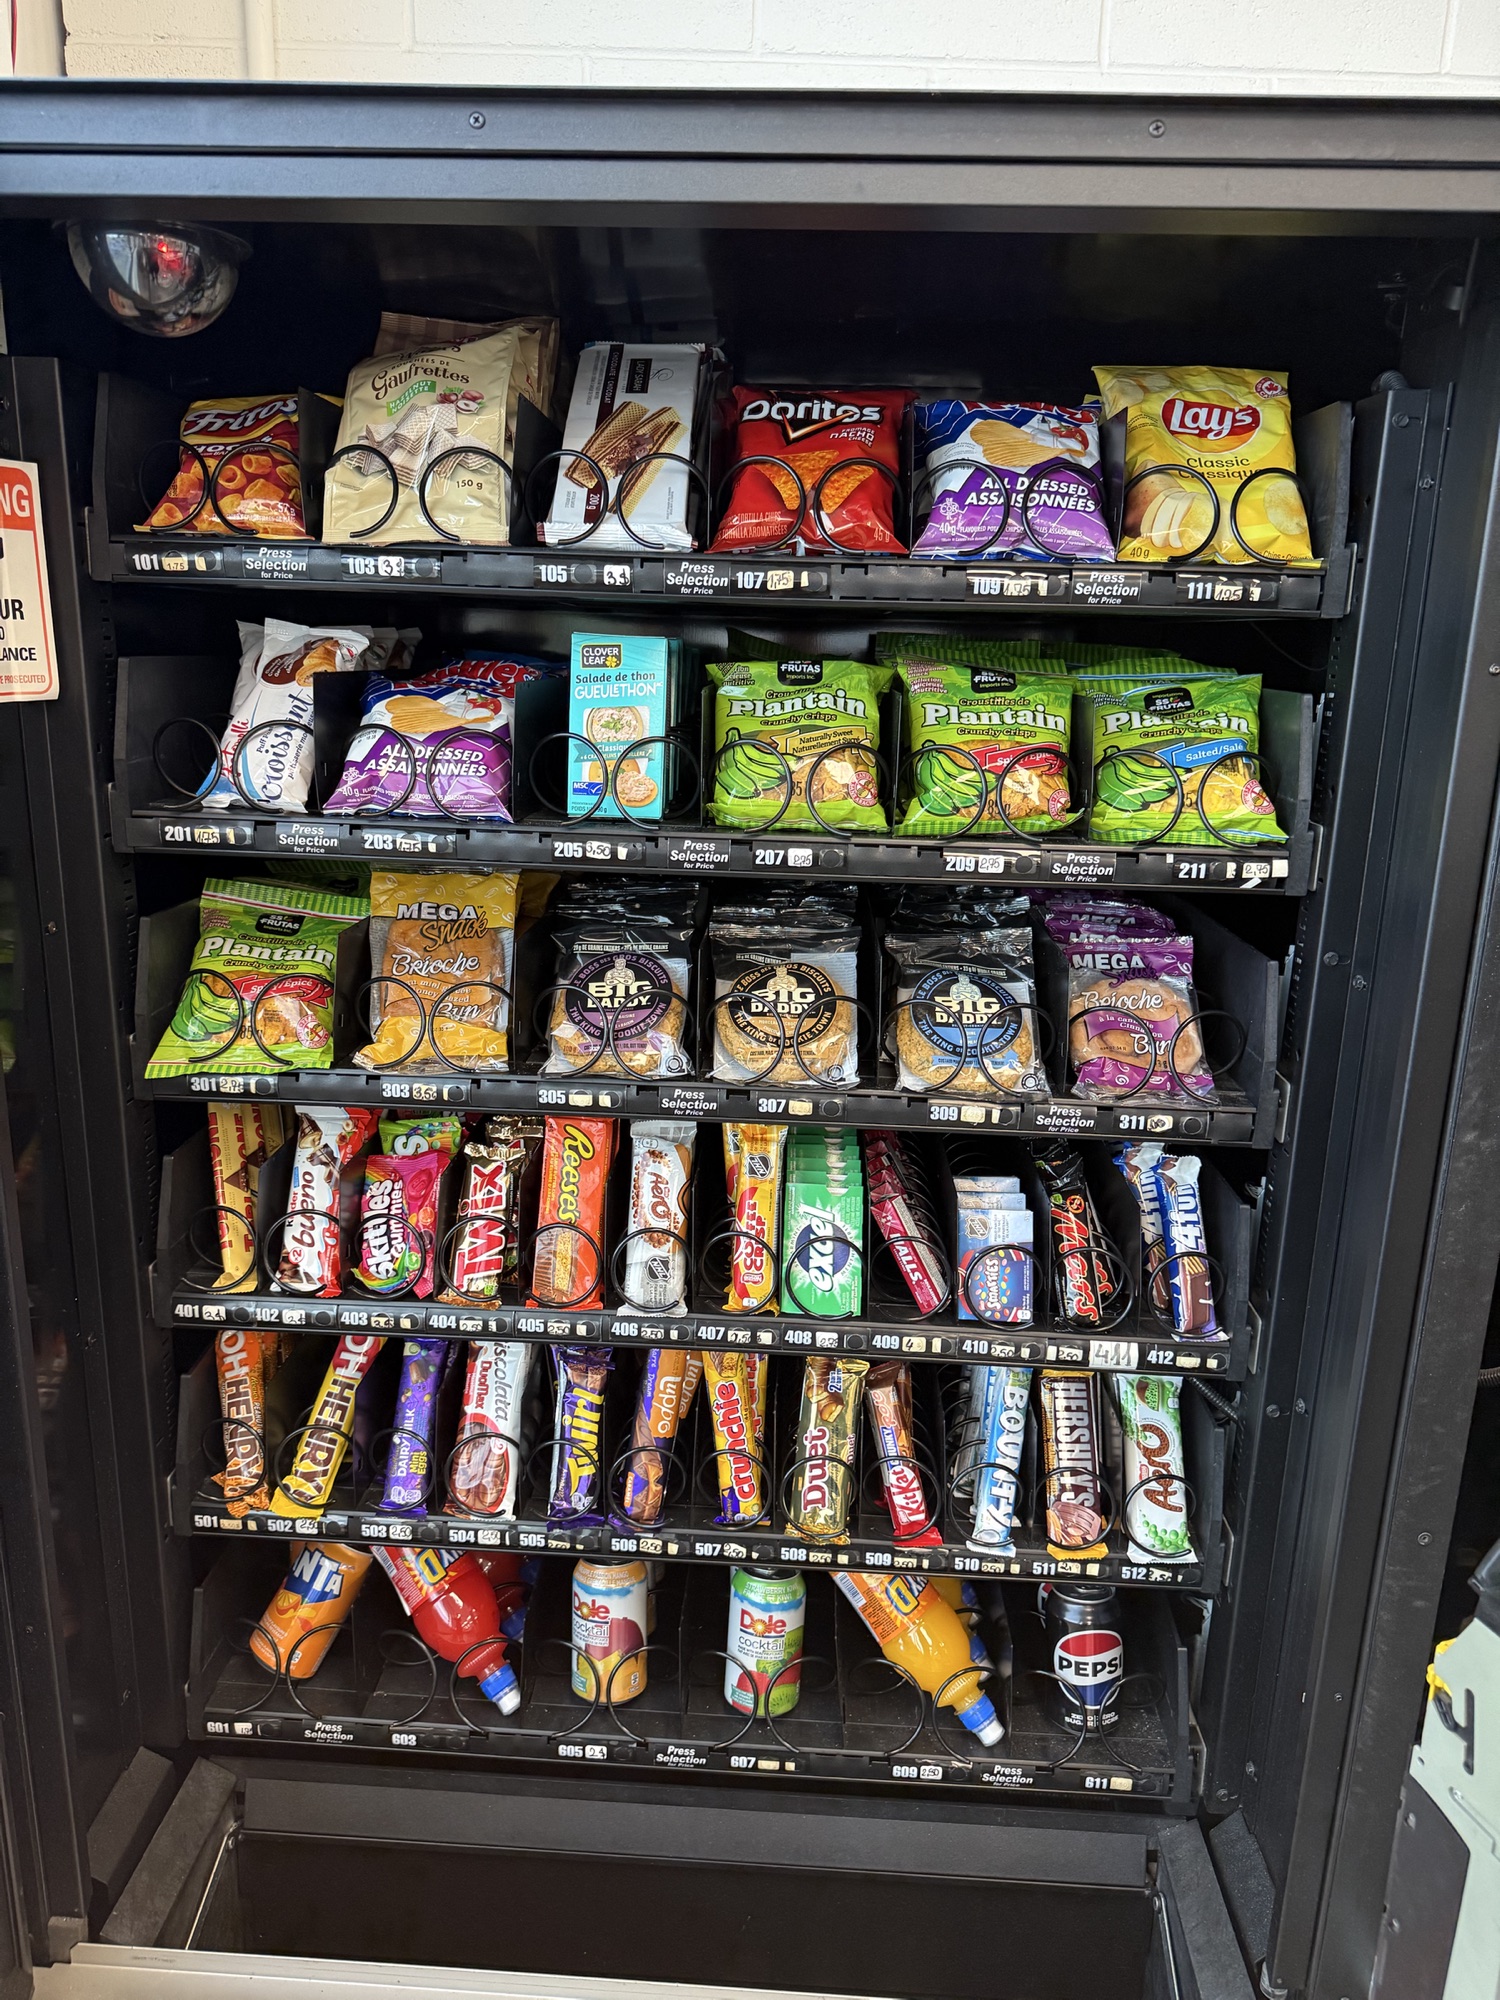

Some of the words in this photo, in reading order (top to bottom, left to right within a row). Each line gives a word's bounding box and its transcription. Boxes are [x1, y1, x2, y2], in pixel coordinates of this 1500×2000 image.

[371, 364, 470, 401] Gaufrettes
[183, 397, 299, 437] Fritos
[741, 400, 884, 423] Doritos
[1169, 399, 1253, 440] Lay's
[841, 427, 875, 435] FROMAGE
[1186, 456, 1250, 469] Classic
[456, 479, 474, 489] 150
[476, 481, 484, 491] g
[749, 523, 788, 538] AROMATISÉES
[873, 527, 883, 541] 45
[939, 522, 950, 534] 40
[259, 547, 292, 559] Press
[1130, 548, 1142, 558] 40
[132, 553, 160, 570] 101
[167, 562, 185, 570] 1.75
[245, 557, 306, 571] Selection
[349, 557, 376, 575] 103
[680, 562, 714, 573] Press
[539, 564, 568, 583] 105
[666, 572, 729, 586] Selection
[736, 572, 764, 589] 107
[1090, 571, 1125, 583] Press
[973, 578, 1000, 595] 109
[1074, 582, 1139, 597] Selection
[1187, 582, 1213, 599] 111
[583, 647, 619, 658] CLOVER
[583, 656, 606, 666] LEAF
[780, 662, 820, 674] FRUTAS
[575, 673, 612, 684] Salade
[615, 672, 627, 682] de
[630, 671, 656, 681] thon
[723, 678, 755, 686] nutritive
[574, 682, 656, 700] GUEULETHON
[1152, 691, 1184, 699] Importations
[726, 687, 869, 720] Plantain
[959, 697, 1016, 707] Croustilles
[1017, 697, 1030, 706] de
[760, 715, 802, 727] Crunchy
[804, 711, 838, 722] Crisps
[921, 703, 1067, 735] Plantain
[799, 732, 833, 745] Naturally
[833, 728, 854, 739] Sweet
[957, 727, 1001, 738] Crunchy
[1002, 727, 1037, 738] Crisps
[1140, 727, 1186, 739] Crunchy
[1186, 742, 1244, 762] Salted/Salé
[573, 781, 589, 789] MSC
[164, 826, 193, 842] 201
[291, 823, 325, 834] Press
[278, 834, 338, 847] Selection
[364, 834, 393, 849] 203
[683, 841, 715, 850] Press
[554, 841, 583, 858] 205
[670, 850, 728, 862] Selection
[755, 850, 784, 865] 207
[946, 856, 976, 872] 209
[1067, 853, 1100, 864] Press
[1052, 863, 1113, 877] Selection
[1178, 863, 1206, 878] 211
[396, 902, 479, 921] MEGA
[259, 917, 300, 931] FRUTAS
[420, 912, 489, 952] Snack
[200, 936, 335, 970] Plantain
[222, 959, 266, 970] Crunchy
[267, 962, 300, 971] Crisps
[391, 952, 480, 976] Brioche
[1072, 953, 1147, 970] MEGA
[579, 961, 600, 980] BOSS
[638, 957, 669, 985] BISCUITS
[739, 971, 761, 990] BOSS
[800, 964, 831, 993] BISCUITS
[924, 972, 943, 990] BOSS
[934, 995, 1001, 1014] BIG
[1081, 989, 1165, 1012] Brioche
[569, 1006, 581, 1024] THE
[733, 1011, 749, 1030] THE
[812, 1010, 832, 1034] TOWN
[918, 1019, 931, 1037] THE
[929, 1034, 954, 1052] KING
[190, 1077, 217, 1092] 301
[382, 1083, 410, 1099] 303
[538, 1090, 566, 1105] 305
[674, 1089, 704, 1100] Press
[661, 1099, 717, 1110] Selection
[758, 1099, 787, 1113] 307
[1049, 1105, 1082, 1117] Press
[930, 1106, 958, 1121] 309
[1036, 1115, 1095, 1128] Selection
[1119, 1115, 1145, 1130] 311
[557, 1124, 595, 1227] Reese's
[749, 1158, 767, 1178] NHL
[292, 1170, 315, 1249] bueno
[362, 1178, 398, 1280] Skittles
[453, 1160, 508, 1293] TWIX
[798, 1200, 836, 1293] excel
[651, 1258, 668, 1280] NHL
[1050, 1207, 1099, 1322] Mars
[985, 1257, 1002, 1311] SMARTIES
[174, 1303, 200, 1319] 401
[340, 1311, 368, 1325] 403
[429, 1314, 457, 1329] 404
[517, 1318, 545, 1332] 405
[611, 1322, 638, 1336] 406
[697, 1326, 725, 1341] 407
[784, 1330, 812, 1345] 408
[872, 1334, 900, 1349] 409
[962, 1340, 989, 1355] 410
[220, 1330, 251, 1378] OH
[1093, 1343, 1134, 1368] 411
[1147, 1350, 1175, 1365] 412
[567, 1387, 605, 1498] Twirl
[1054, 1379, 1096, 1508] HERSHEY'S
[399, 1438, 411, 1477] DAIRY
[409, 1451, 419, 1474] Mini
[417, 1450, 428, 1475] Eggs
[985, 1385, 1030, 1529] BOUNTY
[801, 1426, 830, 1513] Duet
[194, 1514, 219, 1528] 501
[267, 1518, 294, 1533] 502
[361, 1523, 387, 1537] 503
[449, 1529, 476, 1543] 504
[519, 1532, 546, 1547] 505
[611, 1538, 638, 1552] 506
[695, 1543, 722, 1557] 507
[780, 1547, 807, 1561] 508
[865, 1551, 892, 1566] 509
[954, 1557, 980, 1571] 510
[1032, 1561, 1056, 1575] 511
[1121, 1565, 1147, 1580] 512
[777, 1593, 793, 1601] KIWI
[573, 1591, 611, 1620] Dole
[739, 1607, 788, 1635] Dole
[738, 1634, 786, 1651] cocktail
[1058, 1654, 1123, 1678] PEPSI
[206, 1721, 230, 1734] 601
[314, 1721, 343, 1732] Press
[304, 1729, 354, 1742] Selection
[391, 1733, 417, 1747] 603
[558, 1744, 584, 1757] 605
[667, 1745, 696, 1756] Press
[656, 1754, 707, 1765] Selection
[730, 1755, 756, 1768] 607
[892, 1765, 918, 1778] 609
[993, 1765, 1022, 1776] Press
[982, 1773, 1034, 1785] Selection
[1084, 1776, 1108, 1789] 611
